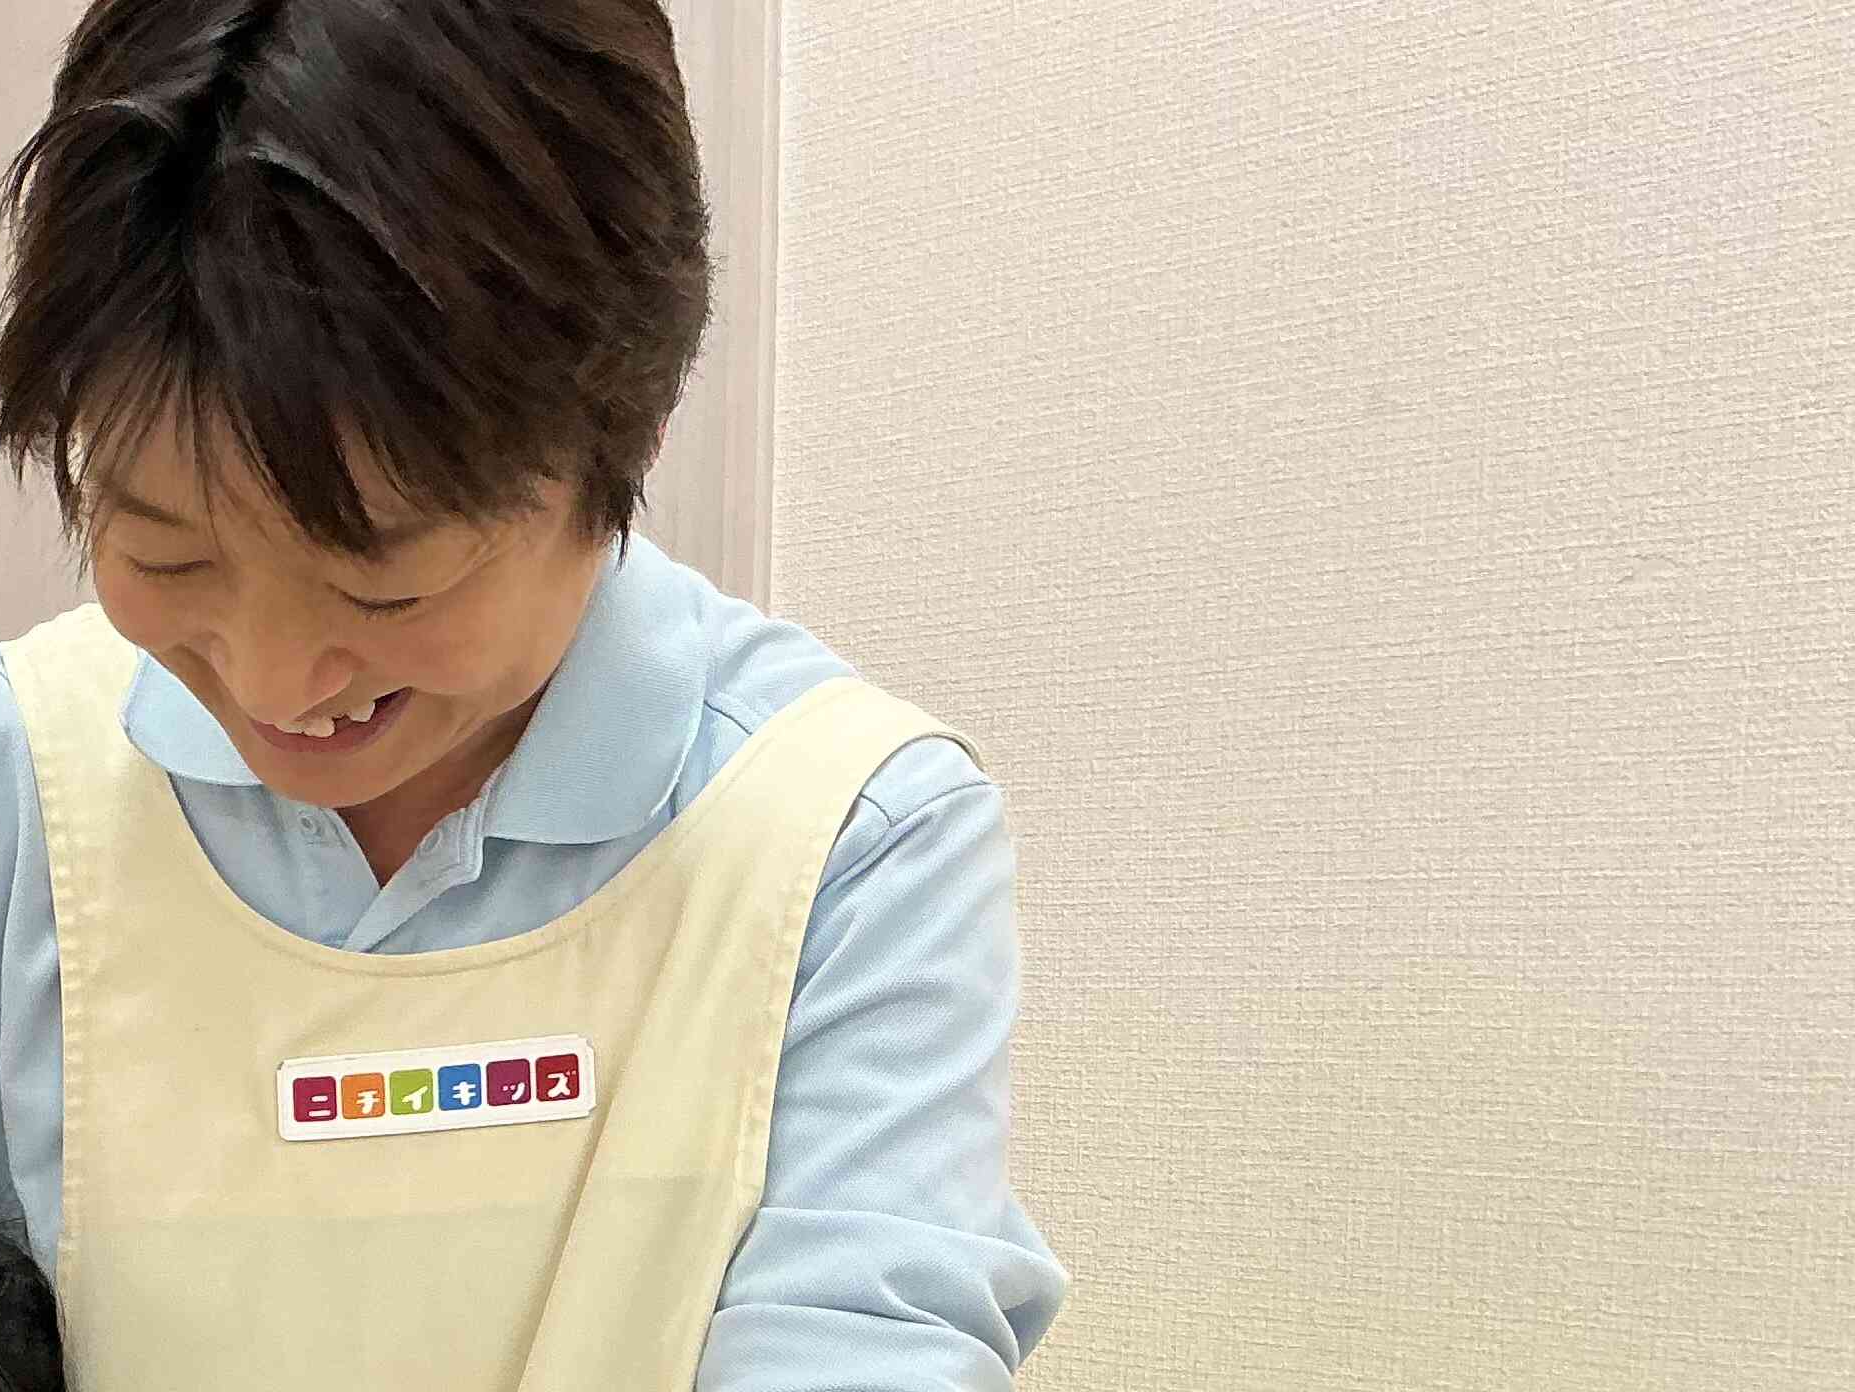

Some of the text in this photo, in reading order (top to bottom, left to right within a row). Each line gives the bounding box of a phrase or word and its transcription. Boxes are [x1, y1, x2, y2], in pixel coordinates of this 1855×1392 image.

[307, 1069, 578, 1117] ニチイキッズ
